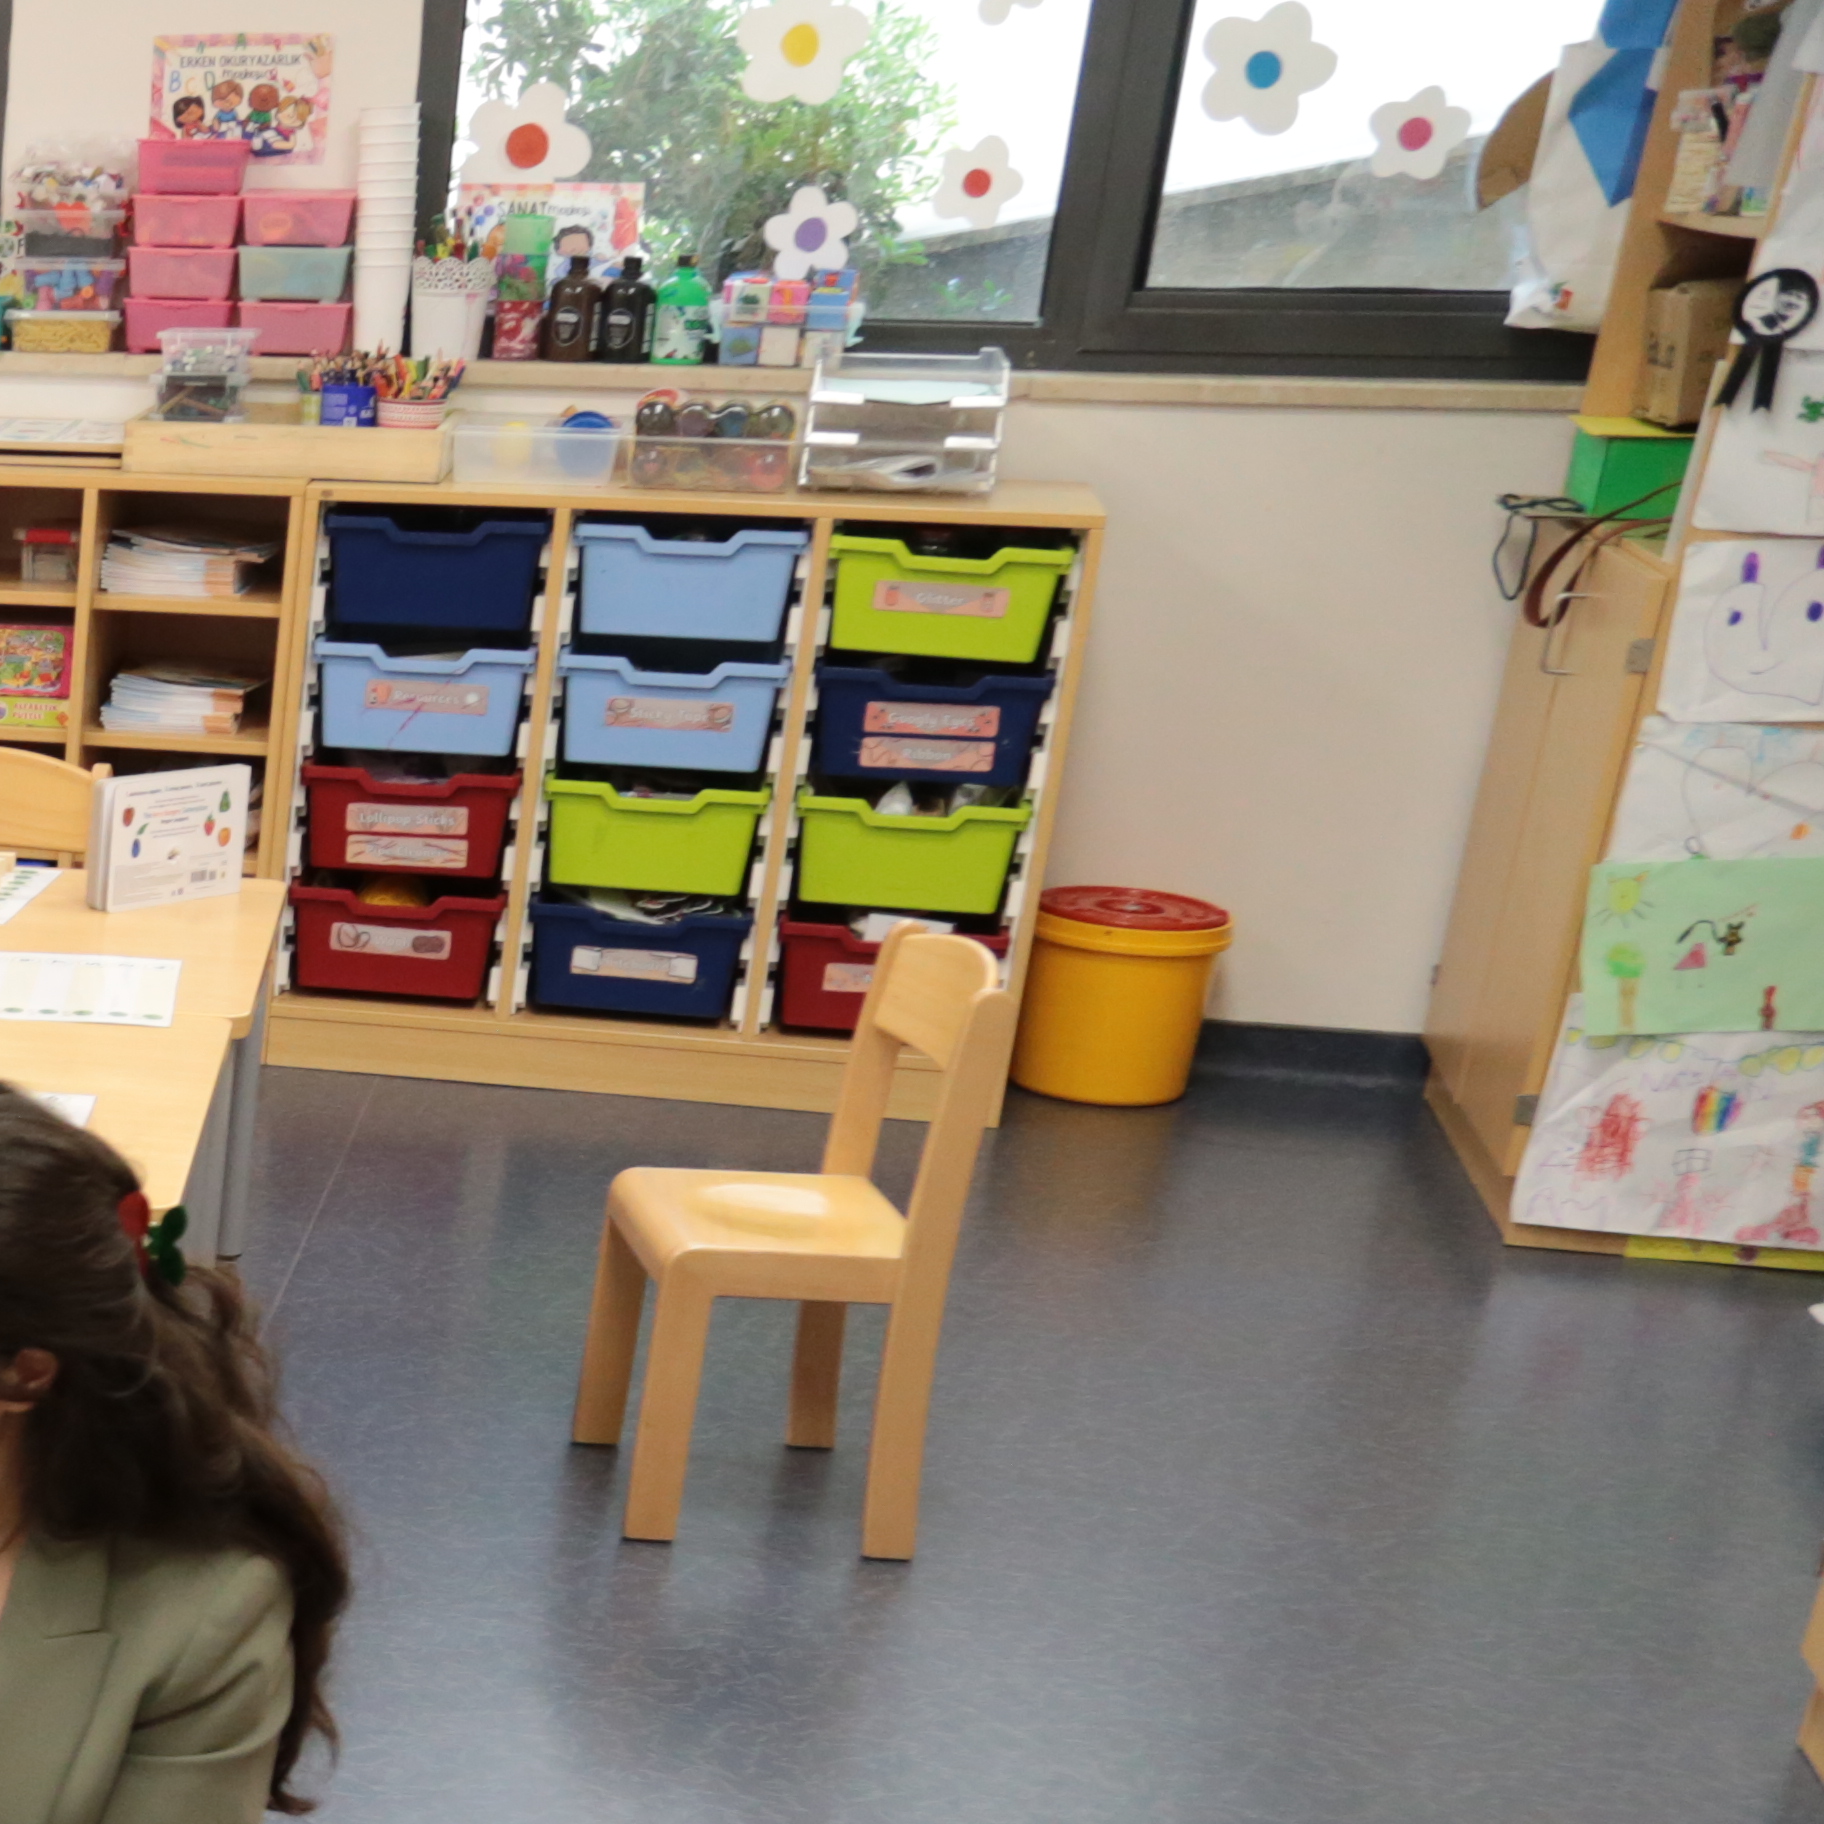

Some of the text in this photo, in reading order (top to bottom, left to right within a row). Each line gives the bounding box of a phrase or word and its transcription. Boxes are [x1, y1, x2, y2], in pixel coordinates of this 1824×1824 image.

[180, 55, 216, 68] ERKEN
[169, 70, 181, 92] B
[497, 201, 548, 216] SANAT
